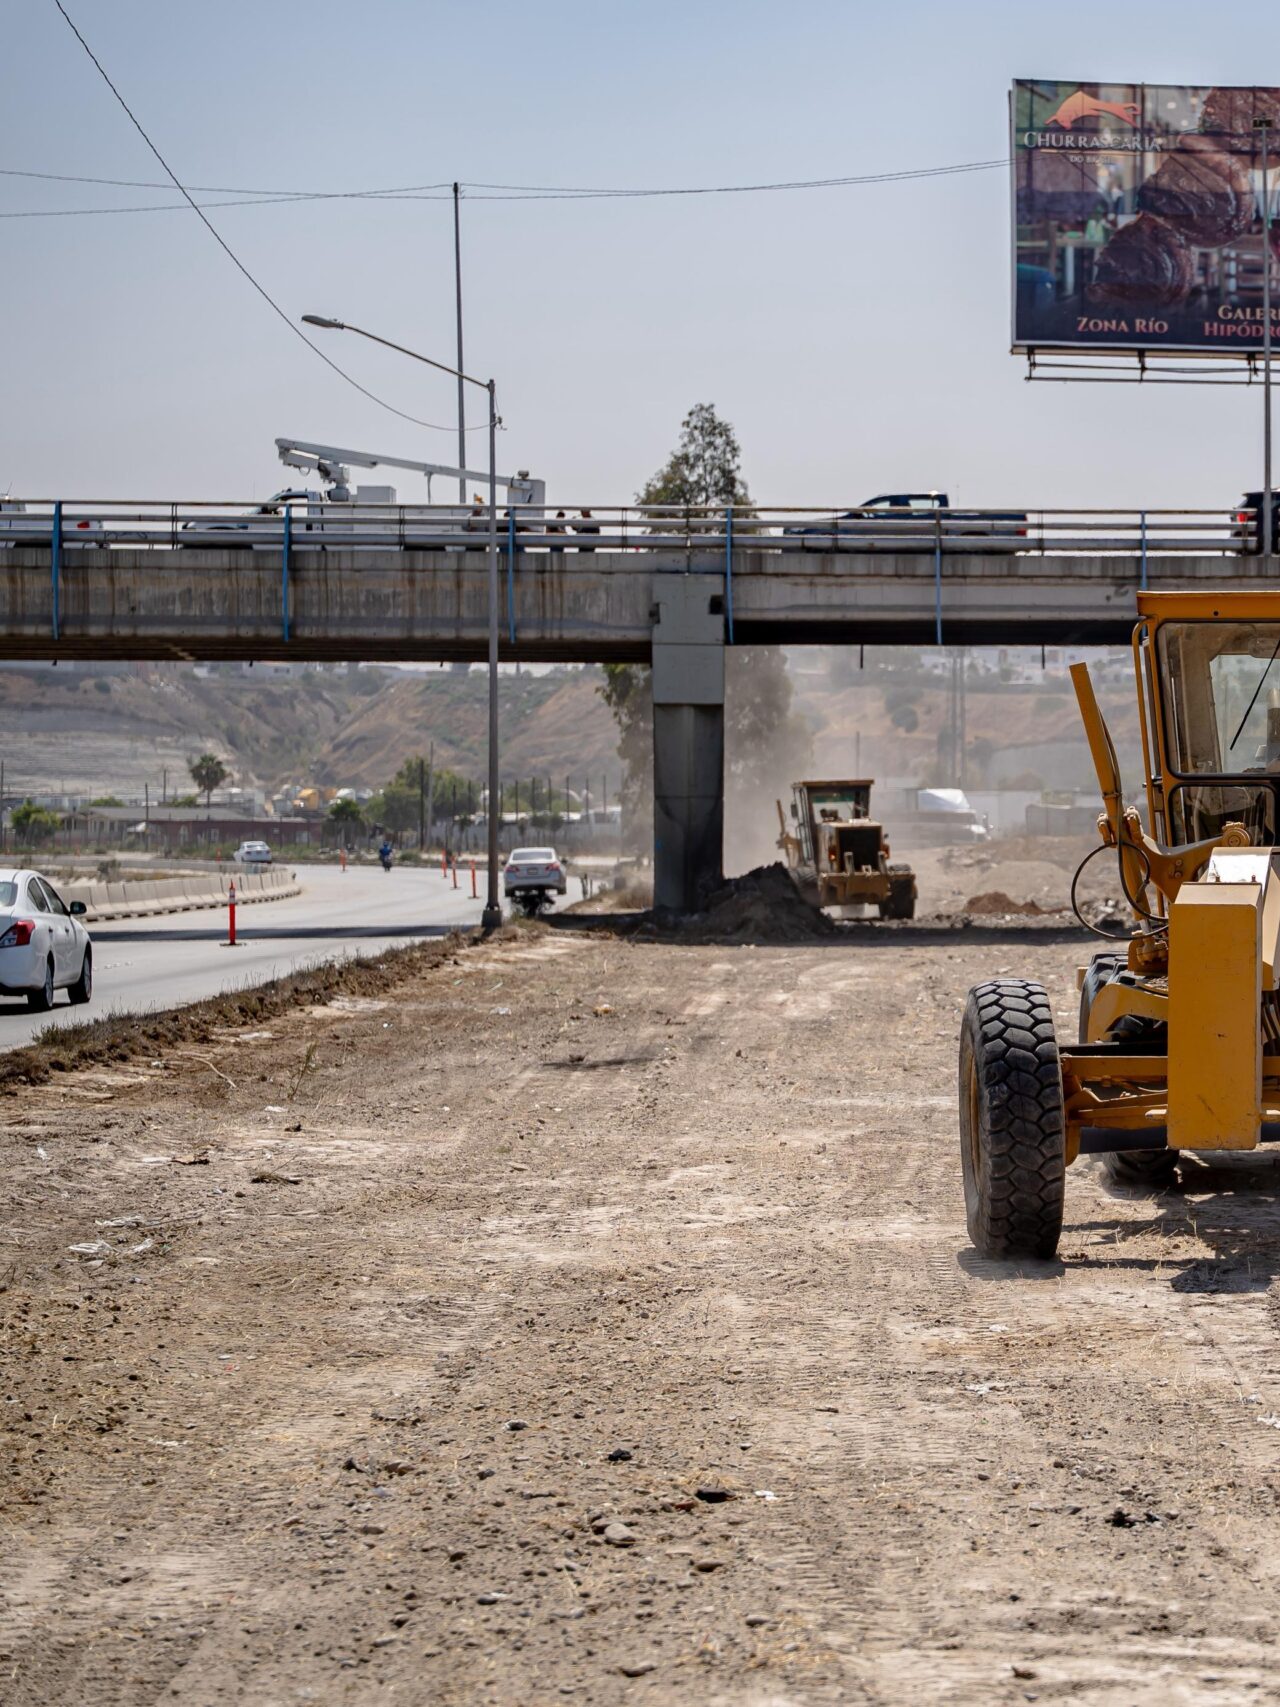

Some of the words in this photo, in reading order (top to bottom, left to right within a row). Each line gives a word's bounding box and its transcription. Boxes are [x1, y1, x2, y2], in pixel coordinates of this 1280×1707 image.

[1024, 131, 1161, 151] CHURRASCARIA
[1077, 316, 1129, 333] ZONA
[1135, 317, 1169, 334] RÍO
